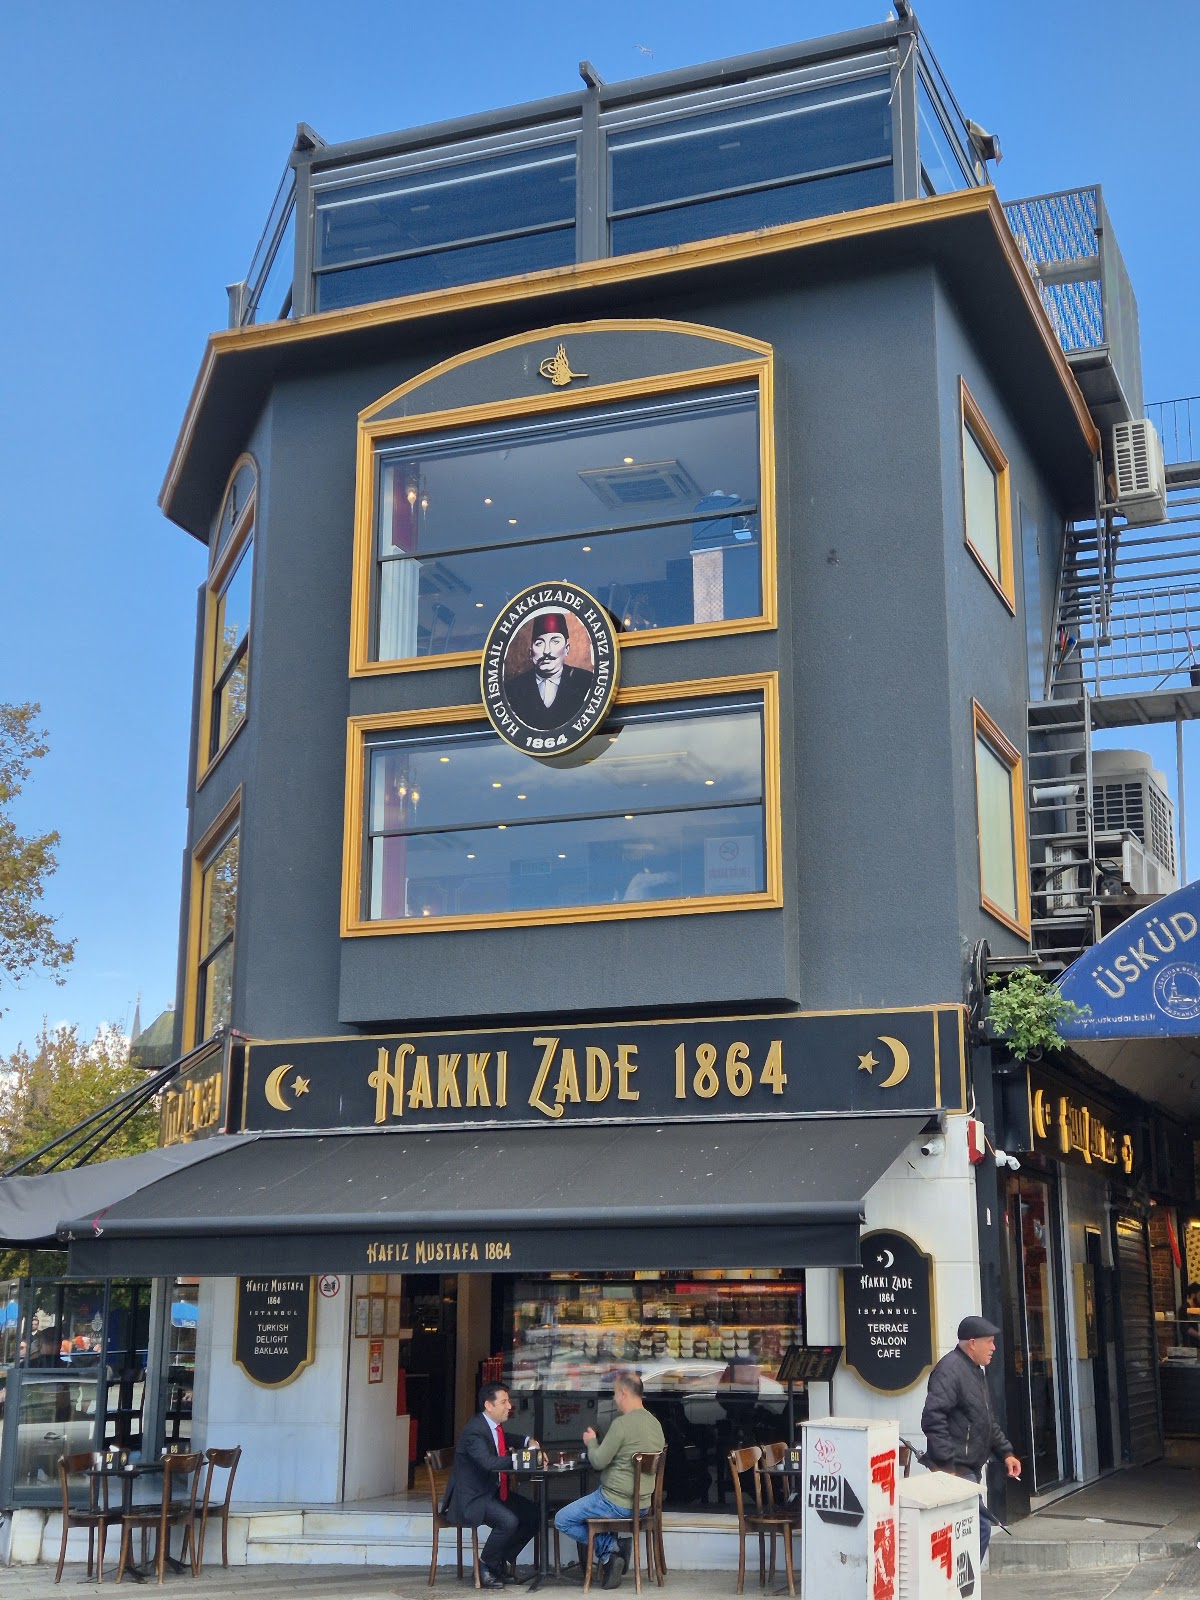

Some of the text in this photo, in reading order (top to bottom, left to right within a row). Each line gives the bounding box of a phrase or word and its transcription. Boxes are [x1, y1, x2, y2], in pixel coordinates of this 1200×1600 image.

[488, 589, 610, 737] HACI İSMAİL HAKKIZADE HAFIZ MUSTAFA
[526, 734, 568, 749] 1864
[1092, 912, 1198, 998] ÜSKÜD
[368, 1037, 788, 1124] HAKKI ZADE 1864
[366, 1240, 512, 1265] HAFIZ MUSTAFA 1864
[246, 1279, 304, 1293] HAFIZ MUSTAFA
[861, 1275, 913, 1291] HAKKI ZADE
[267, 1296, 281, 1305] 1864
[878, 1293, 895, 1303] 1864
[257, 1323, 289, 1332] TURKISH
[868, 1324, 909, 1333] TERRACE
[256, 1335, 288, 1344] DELIGHT
[870, 1336, 907, 1346] SALOON
[254, 1347, 289, 1355] BAKLAVA
[877, 1349, 901, 1359] CAFE
[522, 1451, 531, 1461] B9
[808, 1493, 839, 1510] LEEN
